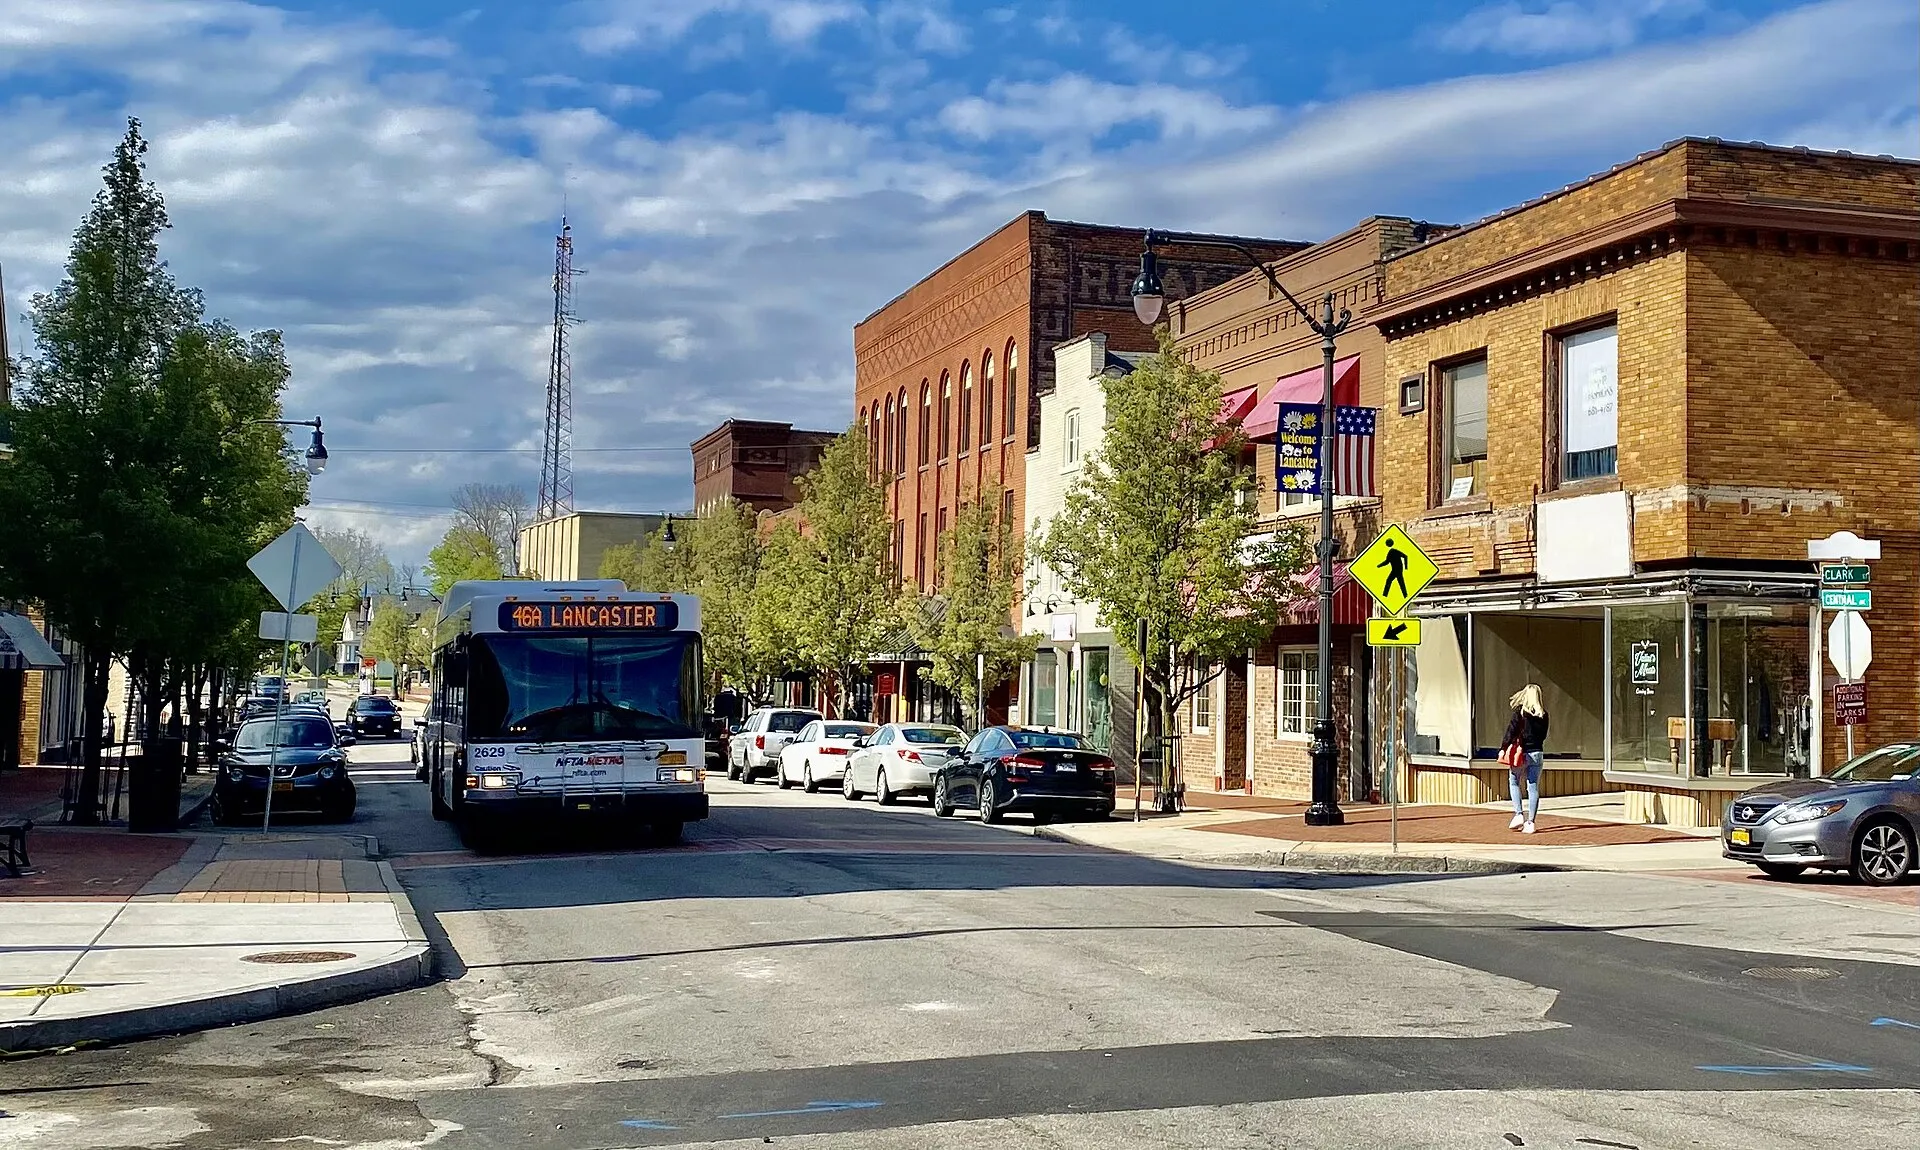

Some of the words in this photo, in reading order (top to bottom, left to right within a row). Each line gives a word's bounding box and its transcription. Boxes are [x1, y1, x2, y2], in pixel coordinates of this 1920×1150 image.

[1281, 432, 1317, 445] Welcome
[1303, 445, 1313, 455] to
[1280, 454, 1317, 469] Lancaster
[1824, 569, 1854, 580] CLARK
[1825, 594, 1857, 605] CENTRAL
[512, 605, 542, 627] 46A
[551, 605, 656, 627] LANCASTER
[1836, 709, 1857, 718] CLARK
[474, 747, 505, 758] 2629
[555, 756, 624, 767] NFTA-METRO
